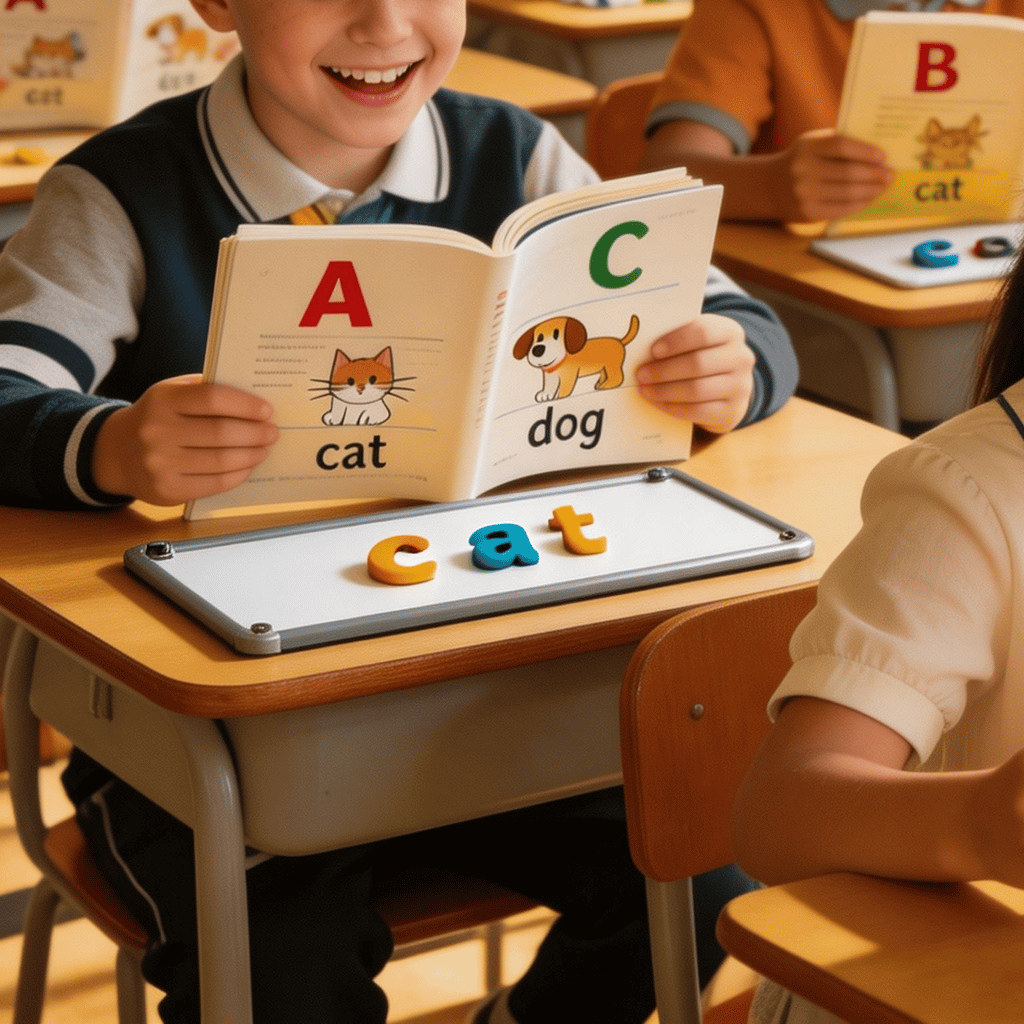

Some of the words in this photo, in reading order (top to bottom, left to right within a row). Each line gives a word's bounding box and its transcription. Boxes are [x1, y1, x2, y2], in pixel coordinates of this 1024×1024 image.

[913, 41, 959, 94] B
[914, 177, 964, 202] cat
[588, 220, 650, 290] C
[298, 260, 374, 328] A
[527, 406, 605, 450] dog
[316, 435, 387, 471] cat
